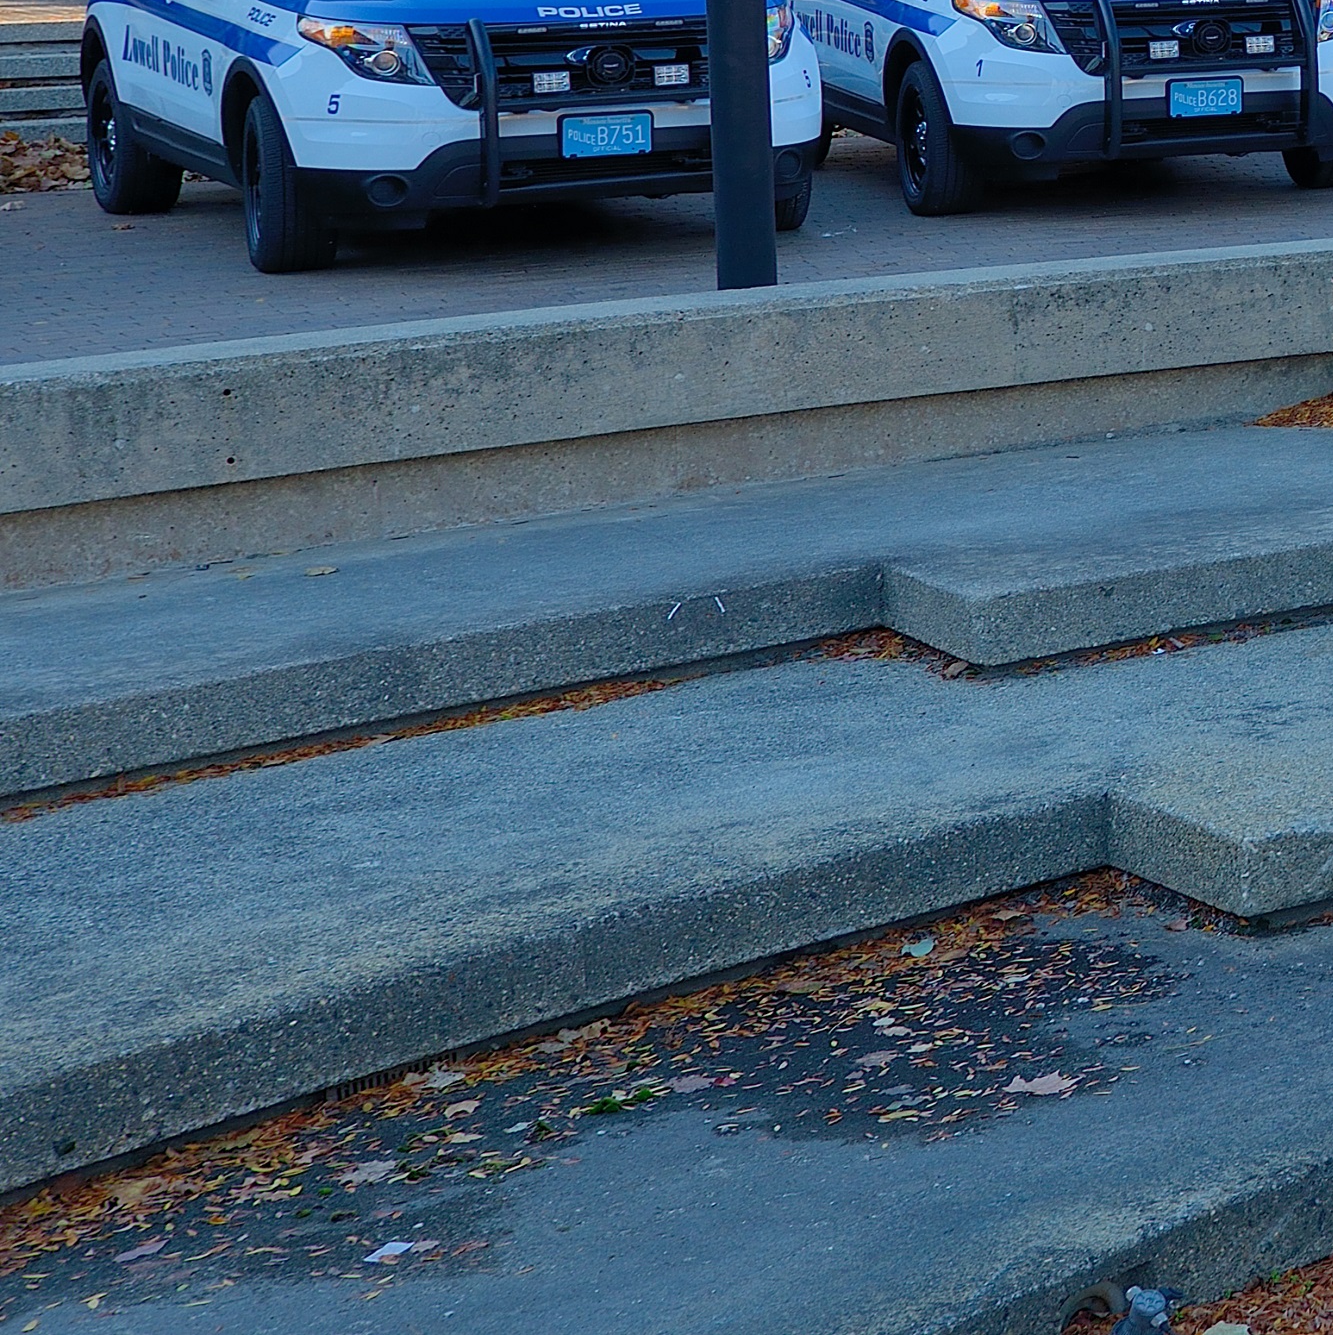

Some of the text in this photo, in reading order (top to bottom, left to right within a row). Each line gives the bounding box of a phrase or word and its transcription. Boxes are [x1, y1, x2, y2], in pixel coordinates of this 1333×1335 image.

[247, 6, 277, 27] POLICE
[537, 3, 643, 18] POLICE
[579, 20, 628, 29] SETINA
[826, 13, 861, 58] Police
[122, 24, 199, 91] Lowell Police
[976, 59, 983, 77] 1
[327, 94, 341, 115] 5
[1174, 88, 1238, 107] POLICE B628
[568, 124, 646, 145] POLICE B751
